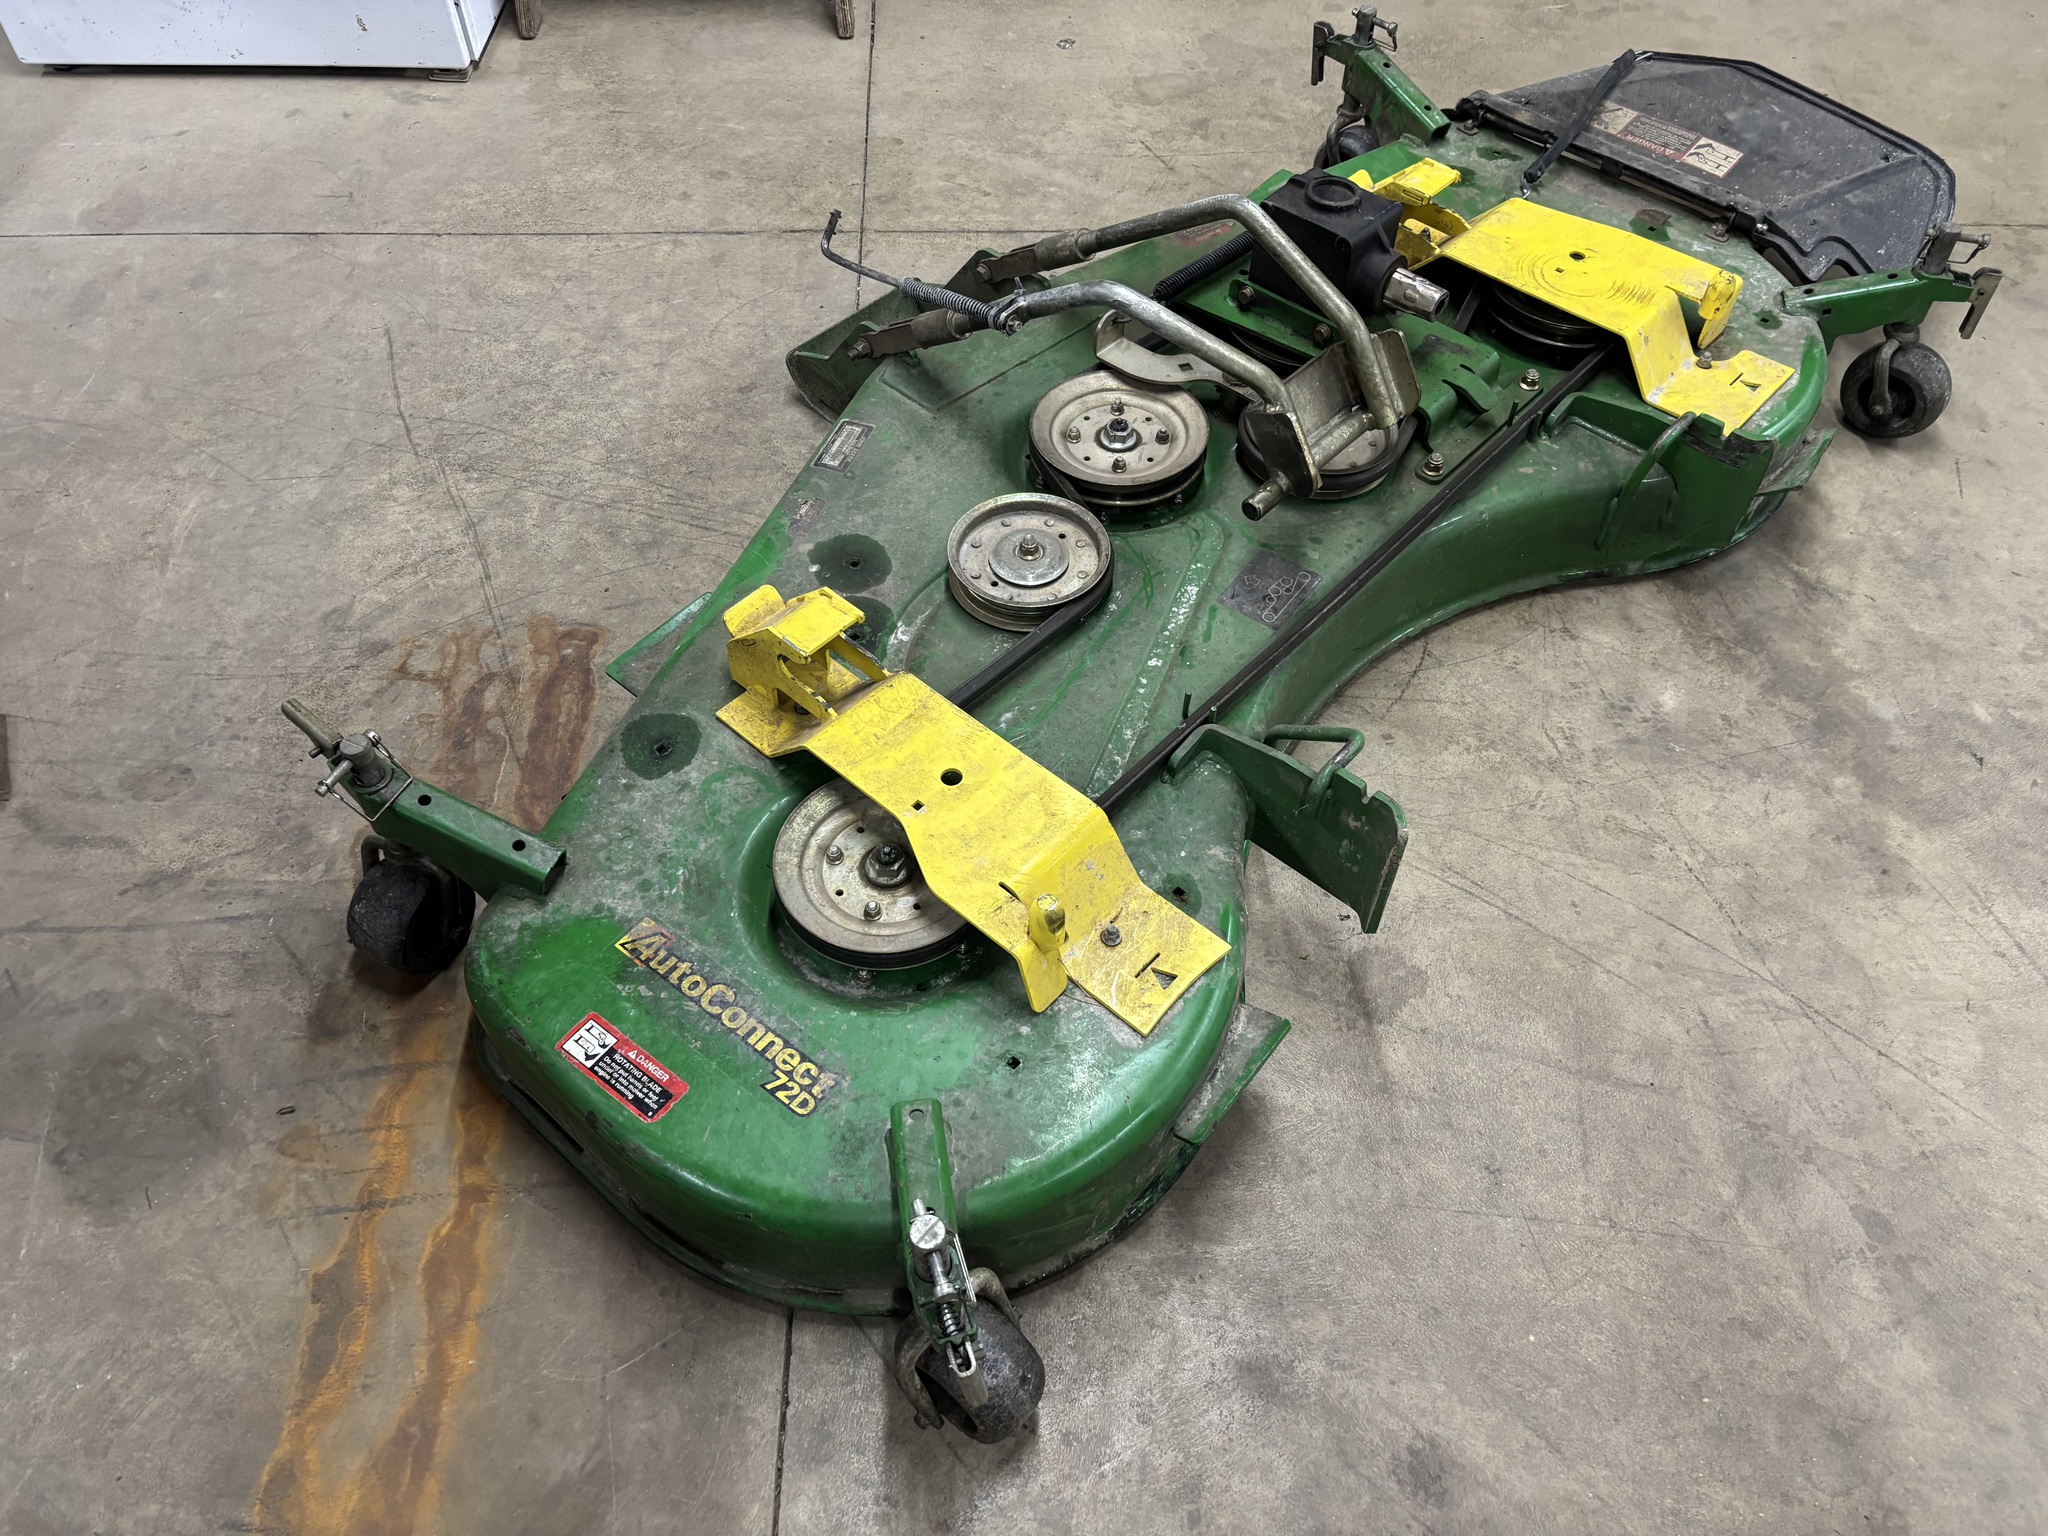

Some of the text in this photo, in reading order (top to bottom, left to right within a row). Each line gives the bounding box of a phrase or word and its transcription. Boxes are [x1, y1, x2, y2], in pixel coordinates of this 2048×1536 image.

[1627, 135, 1664, 153] DANGER
[624, 931, 836, 1099] AutoConnect
[593, 1066, 611, 1080] engine
[614, 1082, 635, 1100] running
[598, 1062, 613, 1073] under
[618, 1076, 629, 1086] into
[628, 1084, 645, 1098] mower
[643, 1097, 659, 1109] when
[603, 1056, 611, 1064] Do
[610, 1062, 620, 1071] not
[618, 1069, 629, 1078] put
[627, 1075, 643, 1089] hands
[613, 1054, 662, 1093] ROTATING BLADE
[636, 1055, 670, 1082] DANGER
[765, 1070, 816, 1115] 72D
